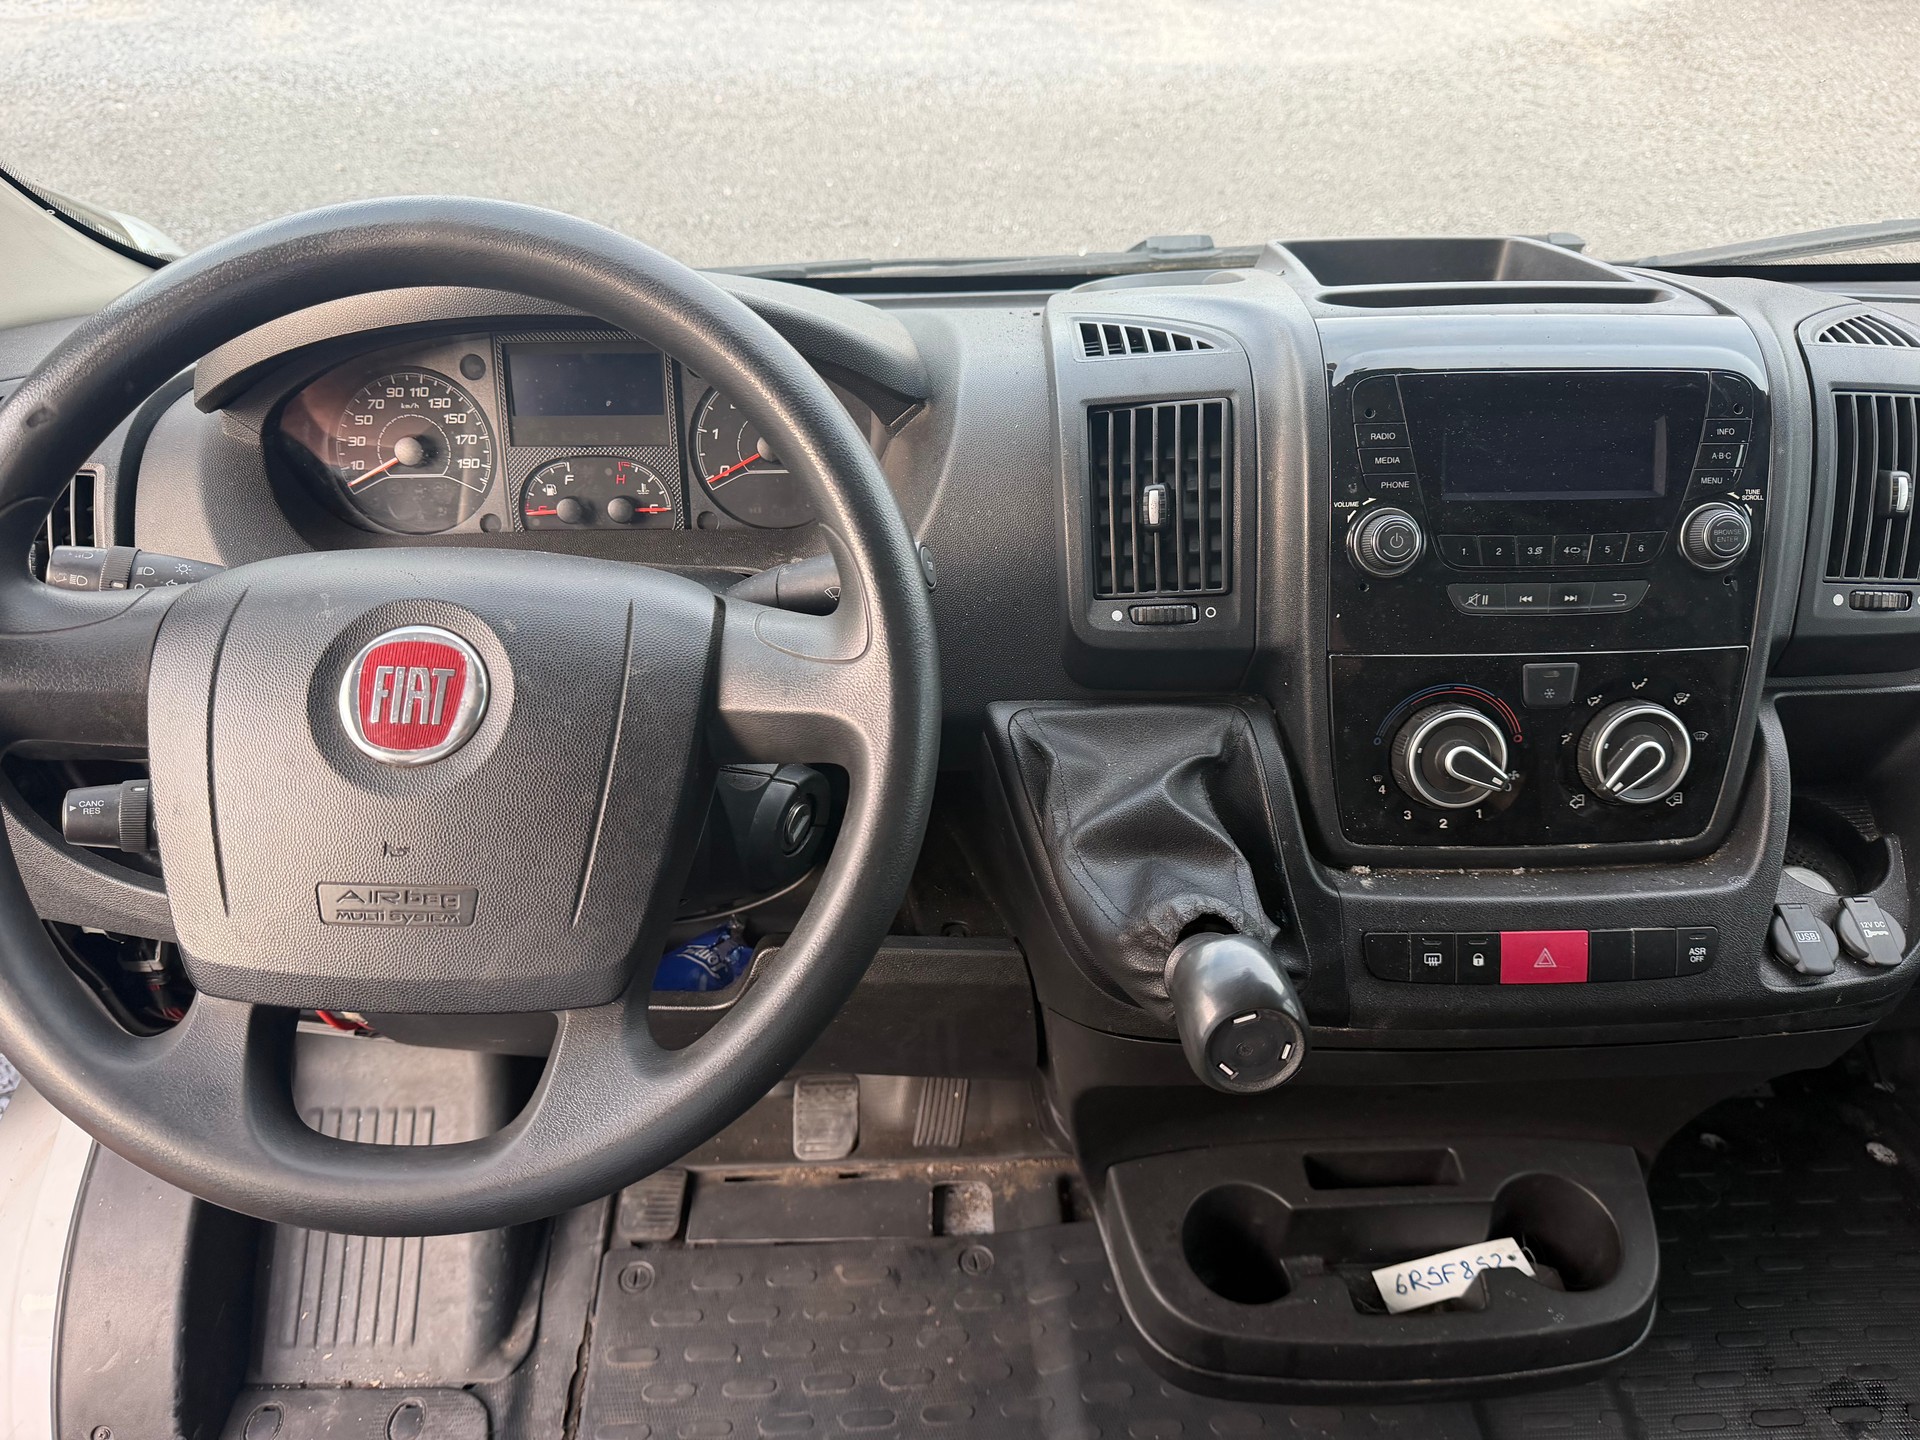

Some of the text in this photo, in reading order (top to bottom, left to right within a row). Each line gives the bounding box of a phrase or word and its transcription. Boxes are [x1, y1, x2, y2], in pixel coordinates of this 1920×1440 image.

[386, 387, 404, 398] 90
[410, 387, 430, 398] 110
[368, 399, 385, 410] 70
[428, 398, 451, 408] 130
[354, 415, 374, 426] 50
[444, 413, 467, 424] 150
[712, 428, 719, 440] 1
[1370, 432, 1396, 440] RADIO
[1716, 428, 1735, 436] INFO
[348, 436, 366, 446] 30
[456, 434, 478, 445] 170
[350, 460, 365, 470] 10
[457, 458, 480, 469] 190
[1374, 456, 1400, 464] MEDIA
[564, 474, 574, 486] F
[616, 474, 626, 485] H
[1380, 480, 1410, 489] PHONE
[1496, 548, 1502, 556] 2
[1527, 547, 1533, 555] 3
[1563, 546, 1570, 554] 4
[1604, 546, 1611, 554] 5
[370, 666, 456, 726] FIAT
[1378, 784, 1386, 794] 4
[1404, 810, 1412, 820] 3
[1476, 808, 1482, 819] 1
[1439, 818, 1448, 829] 2
[1796, 932, 1818, 941] USB
[1689, 947, 1706, 956] ASR
[1690, 955, 1705, 963] OFF
